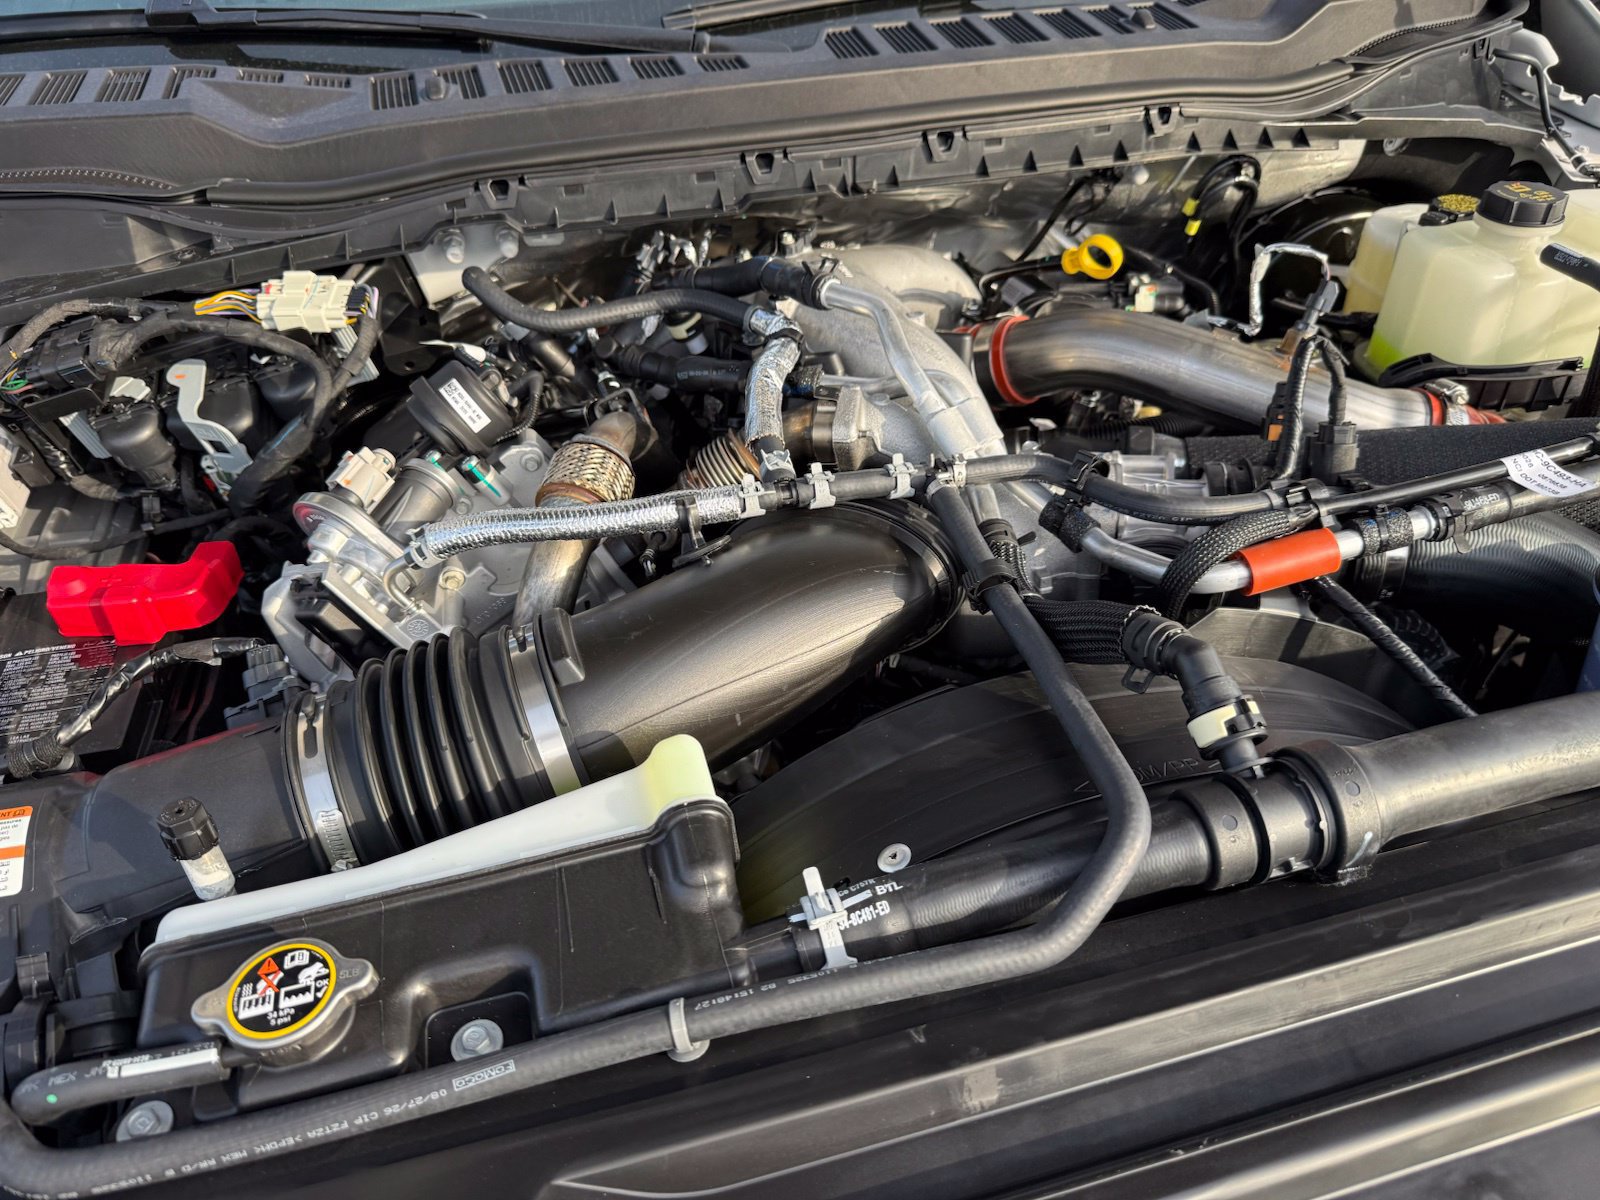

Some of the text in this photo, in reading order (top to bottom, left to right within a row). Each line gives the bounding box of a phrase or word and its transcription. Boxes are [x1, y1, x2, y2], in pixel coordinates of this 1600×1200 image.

[875, 880, 904, 896] BTL
[316, 979, 329, 988] OK
[384, 1088, 447, 1115] 08/27/26
[353, 1111, 378, 1125] CIP
